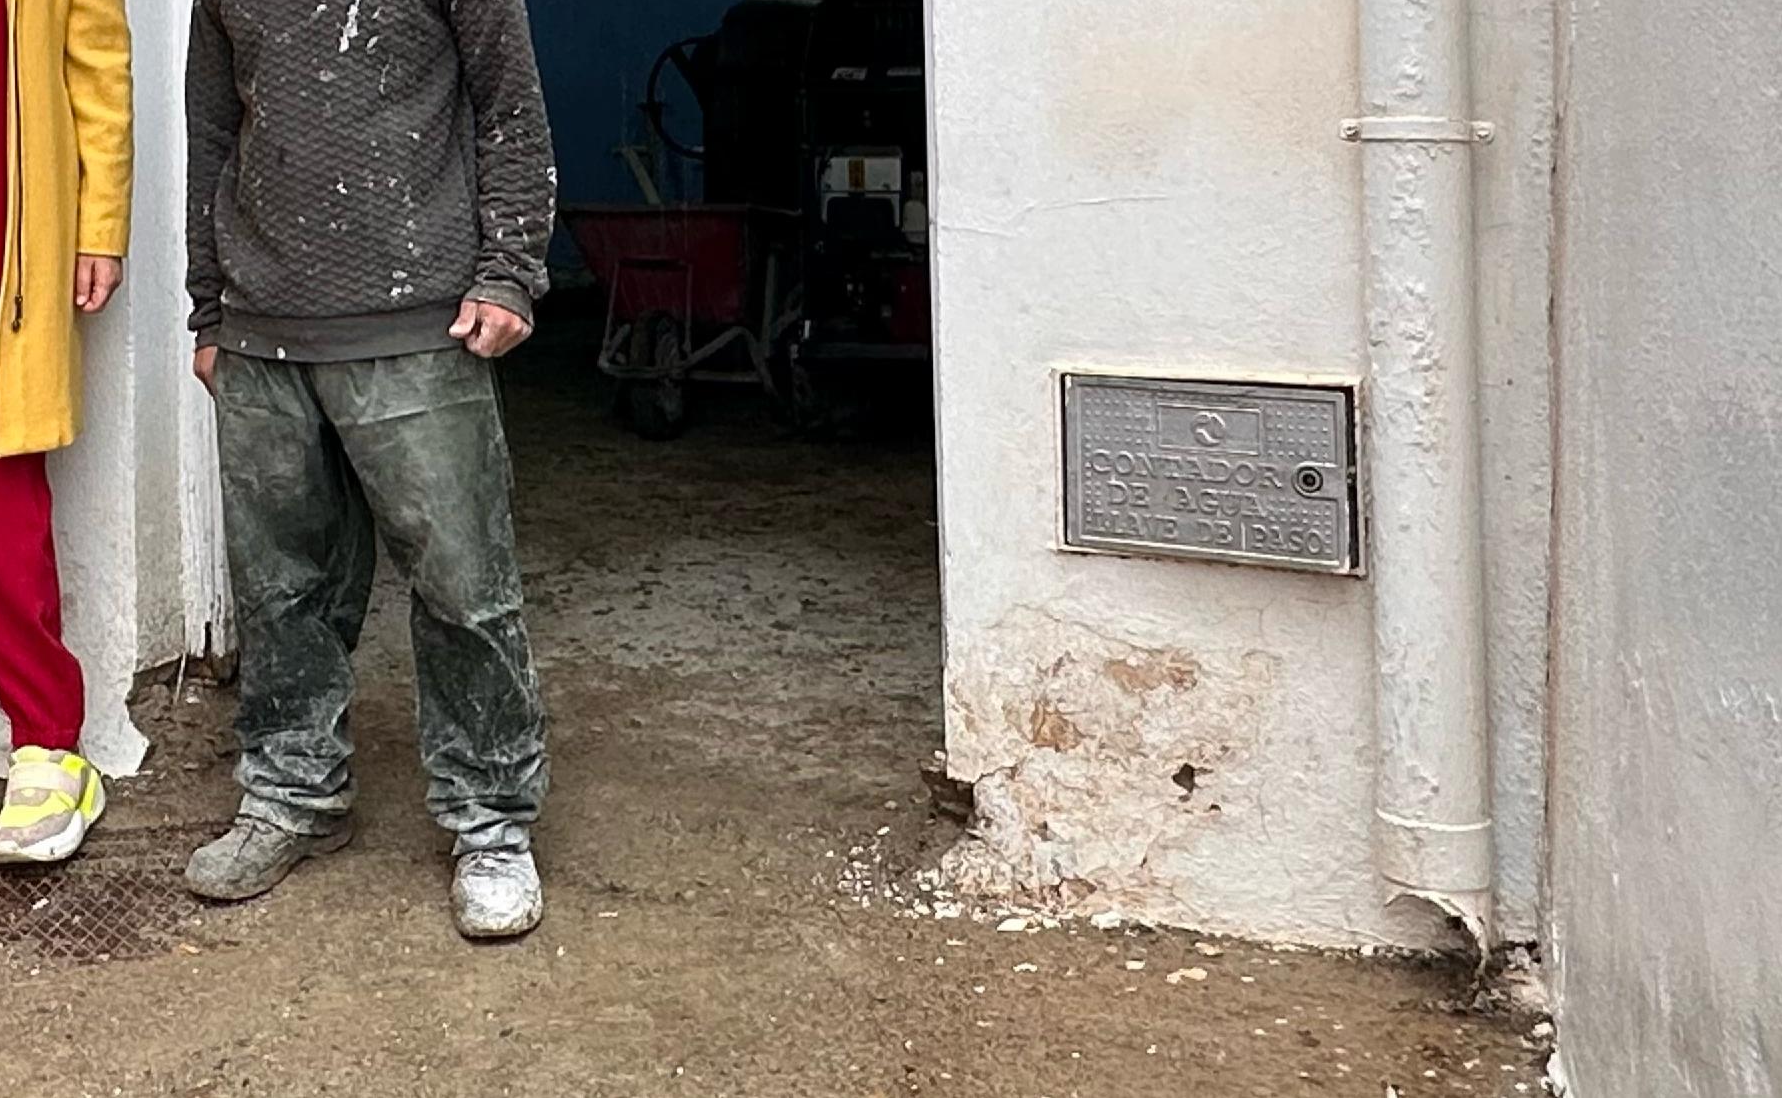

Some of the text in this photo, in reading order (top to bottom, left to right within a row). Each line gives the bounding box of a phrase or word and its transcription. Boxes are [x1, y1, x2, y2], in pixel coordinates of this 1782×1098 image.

[1089, 448, 1283, 489] CONTADOR
[1106, 479, 1268, 519] DE AGUA
[1250, 523, 1324, 555] PASO
